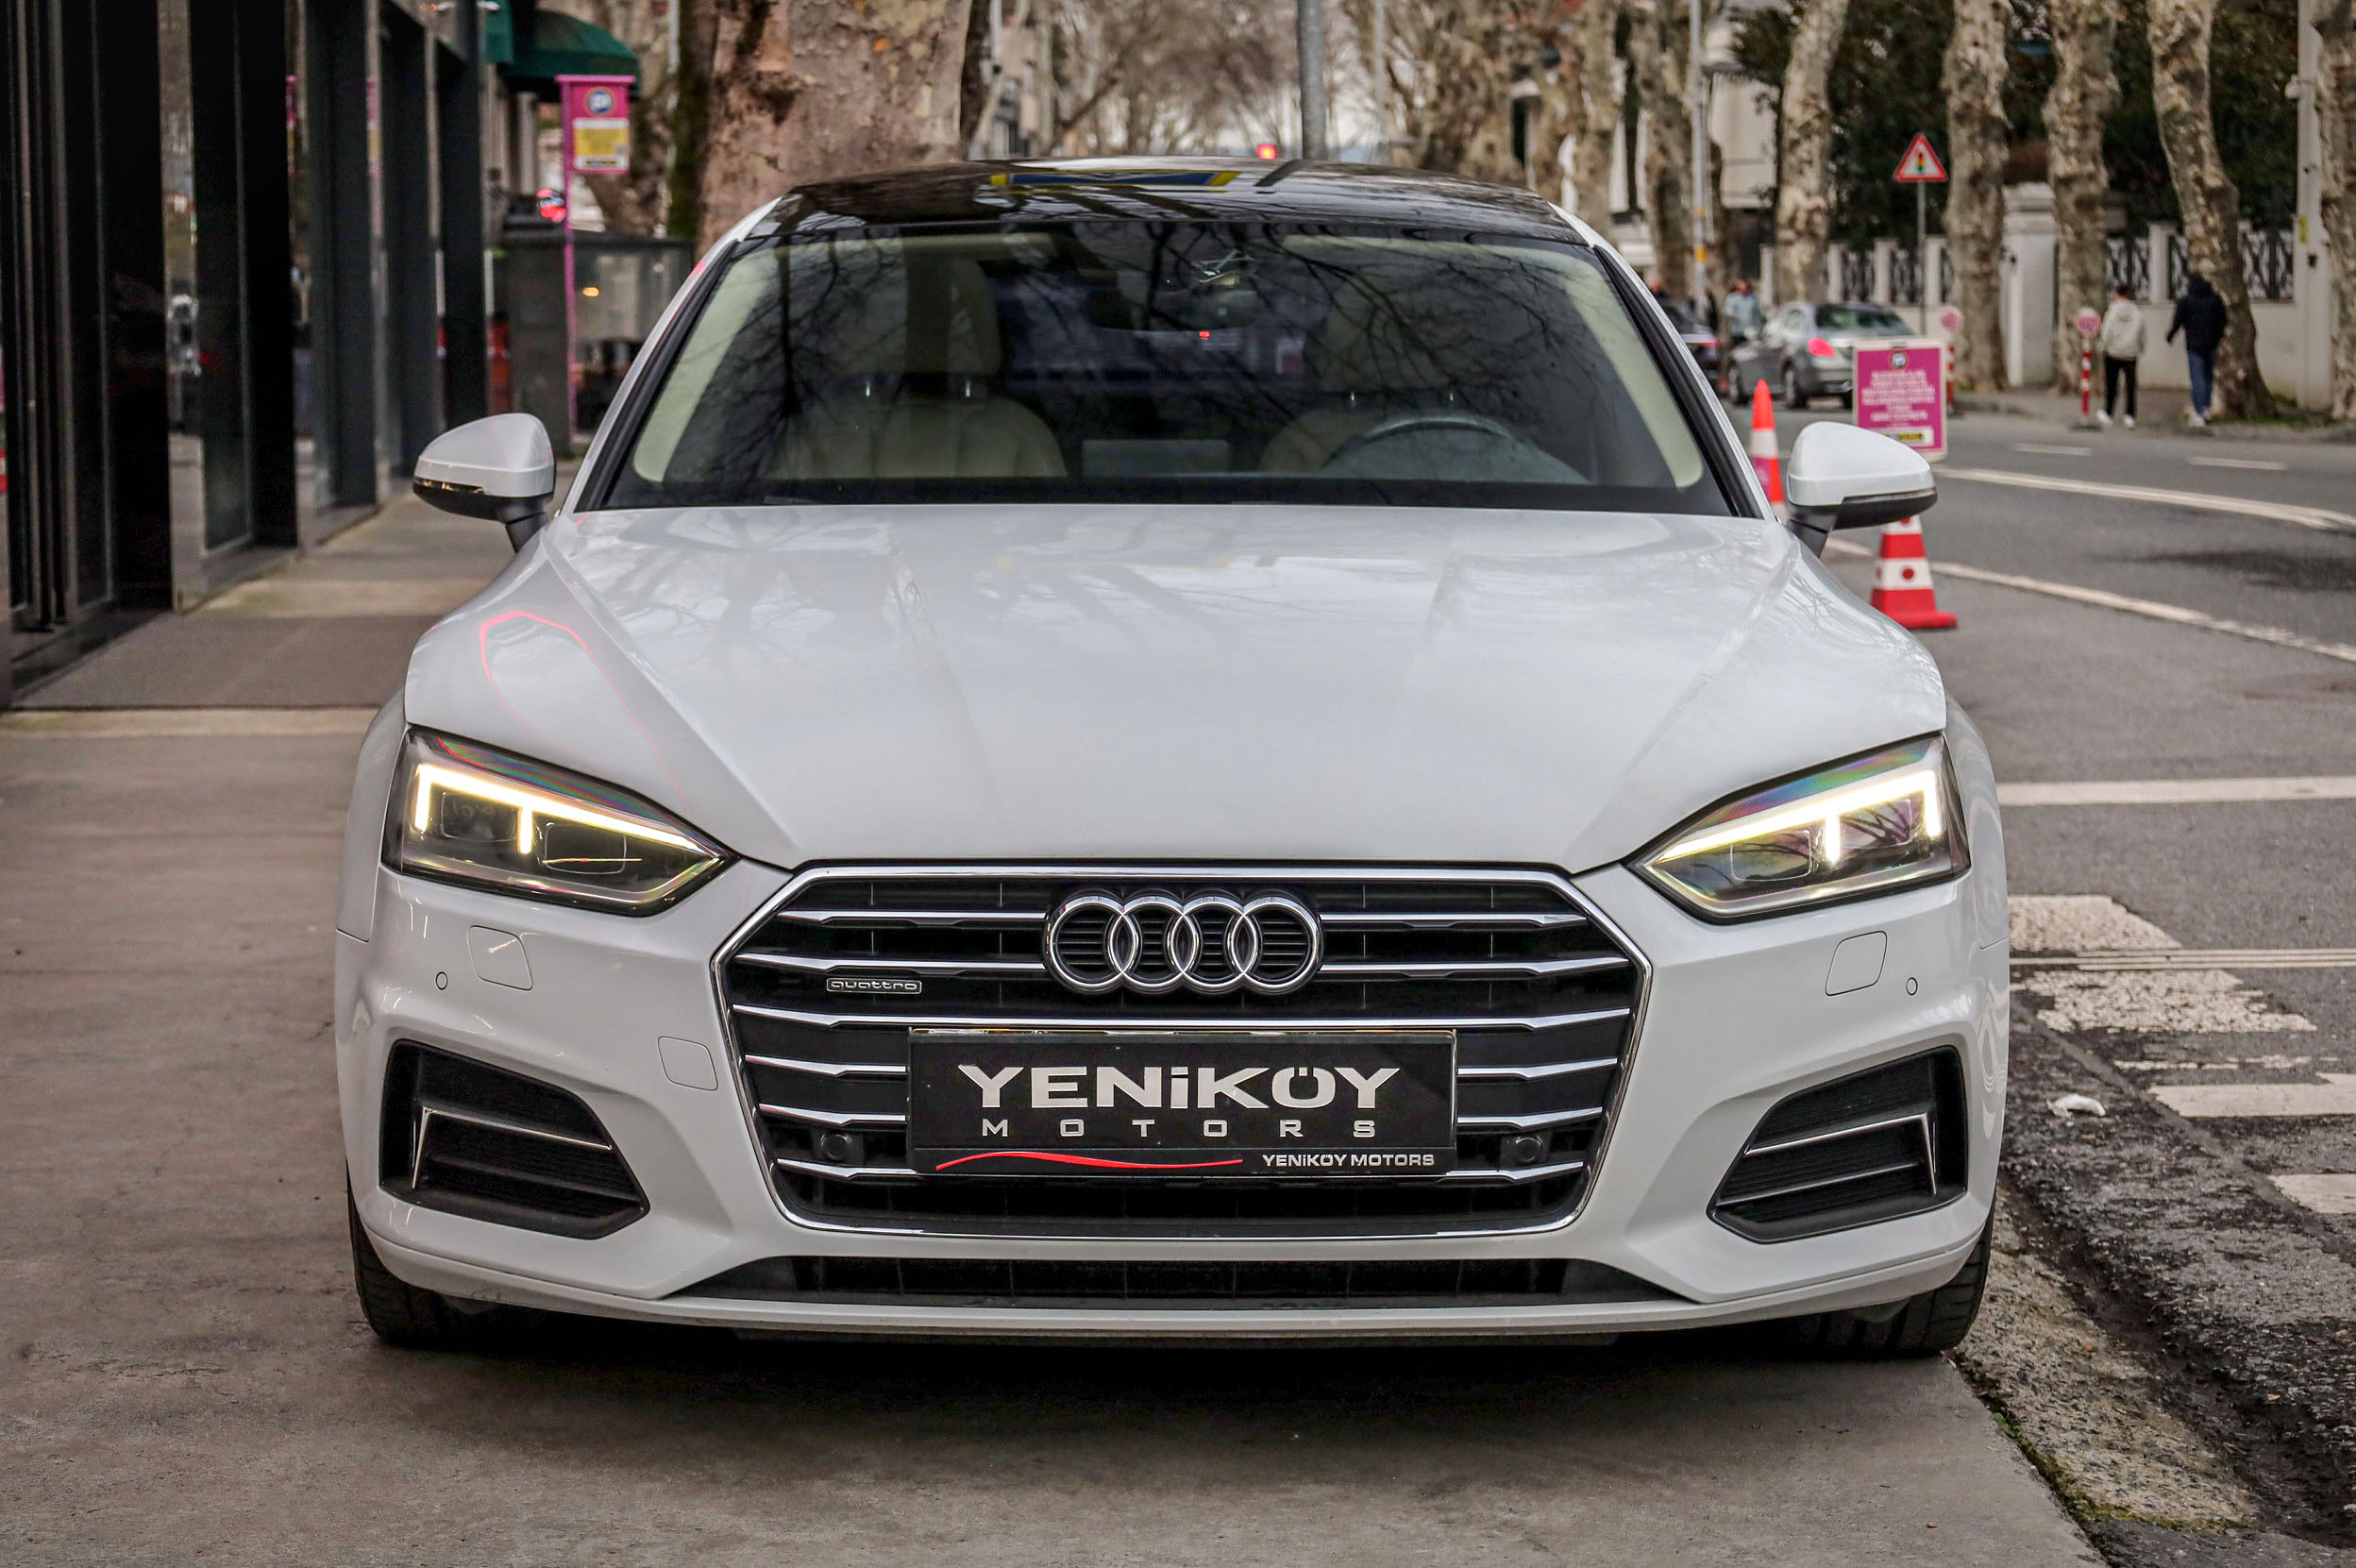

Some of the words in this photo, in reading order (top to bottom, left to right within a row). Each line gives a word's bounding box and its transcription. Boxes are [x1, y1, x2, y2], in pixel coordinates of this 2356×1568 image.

[831, 980, 917, 990] quattro
[982, 1118, 1375, 1138] MOTORS
[1350, 1154, 1435, 1167] MOTORS
